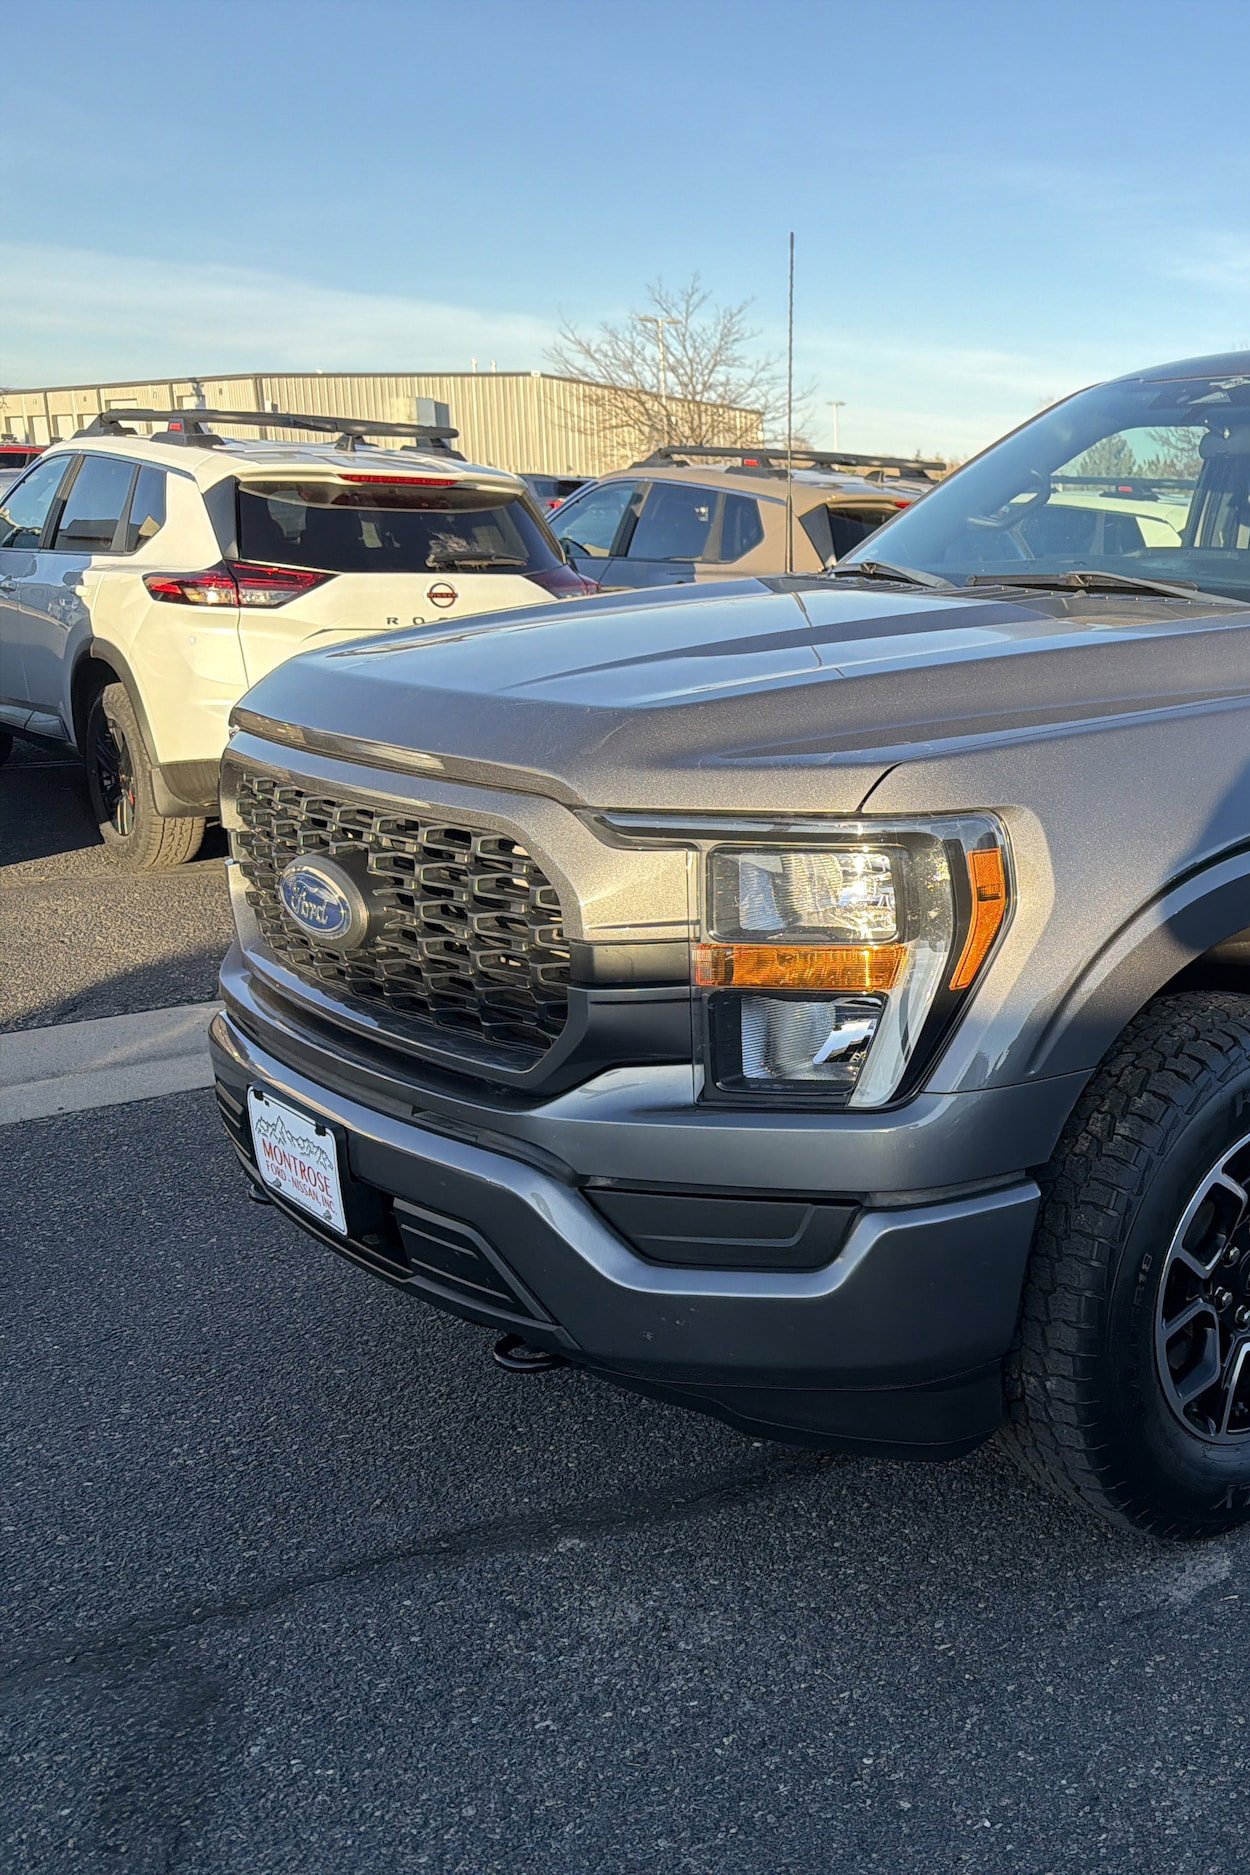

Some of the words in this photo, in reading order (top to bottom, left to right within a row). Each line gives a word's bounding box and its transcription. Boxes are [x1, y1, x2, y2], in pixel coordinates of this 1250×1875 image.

[288, 878, 339, 926] Ford
[262, 1138, 333, 1199] MONTROSE
[266, 1160, 287, 1182] FORD
[291, 1176, 321, 1207] NISSAN,
